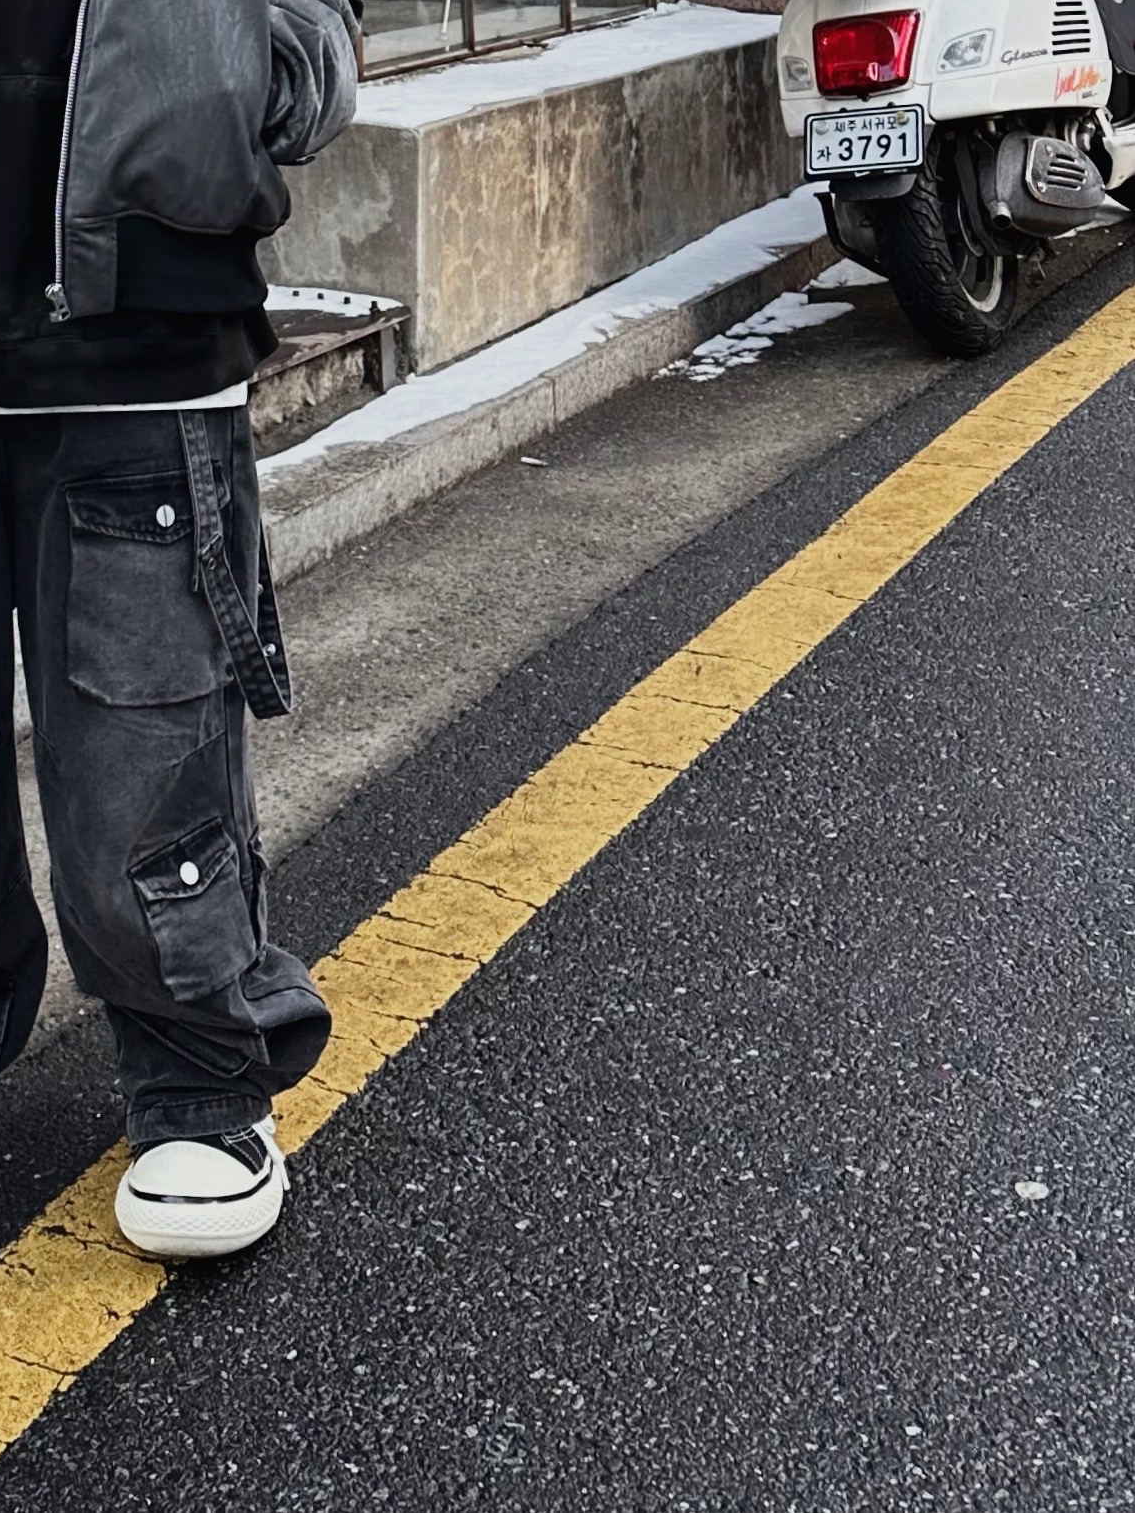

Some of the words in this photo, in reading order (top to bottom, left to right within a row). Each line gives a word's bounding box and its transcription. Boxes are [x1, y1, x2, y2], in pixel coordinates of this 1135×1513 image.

[834, 120, 856, 133] 제주
[816, 146, 831, 162] 자
[838, 132, 907, 162] 3791
